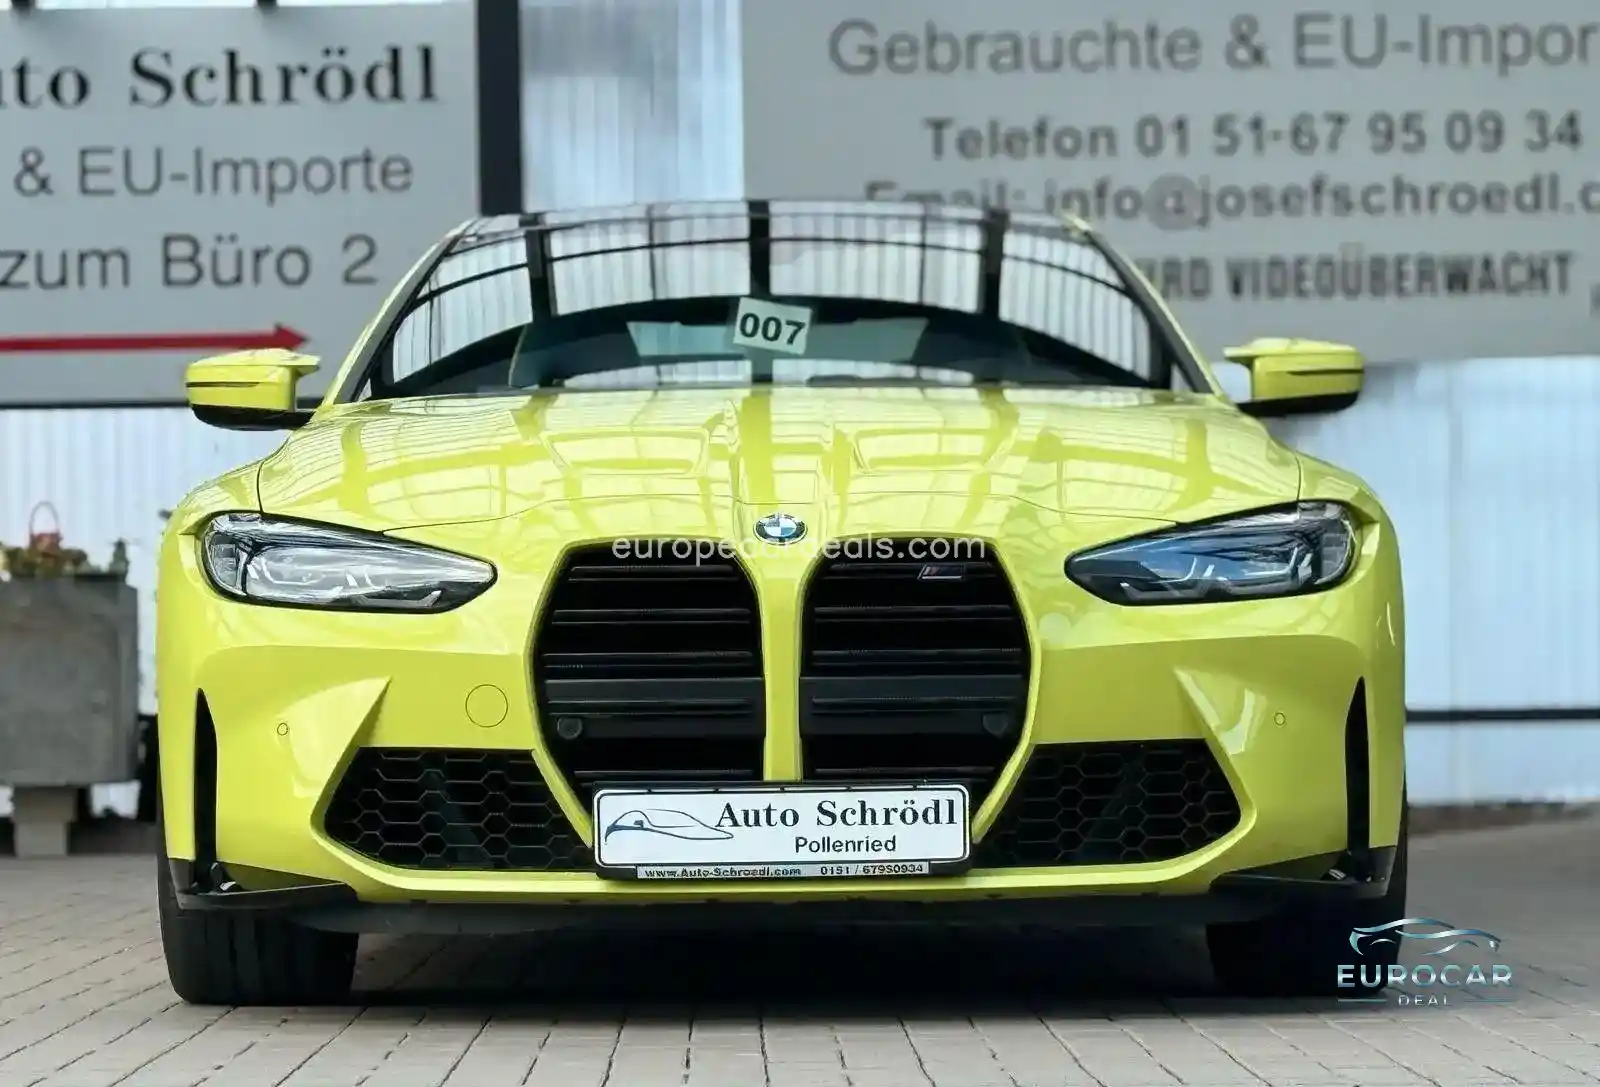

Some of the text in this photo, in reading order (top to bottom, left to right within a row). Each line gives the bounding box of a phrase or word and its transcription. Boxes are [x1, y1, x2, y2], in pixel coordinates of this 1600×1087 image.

[827, 18, 1202, 74] Gebrauchte
[1224, 13, 1270, 70] &
[0, 45, 439, 111] to Schrödl
[922, 108, 1583, 160] Telefon 01 51-67 95 09 34
[14, 146, 413, 206] & EU-Importe
[0, 233, 378, 290] zum Büro 2
[740, 312, 806, 345] 007
[714, 798, 957, 828] Auto Schrödl
[644, 865, 801, 878] www.Auto-Schroedl.com
[820, 864, 850, 876] 0151
[862, 863, 924, 875] 67950934
[795, 836, 896, 854] Pollenried
